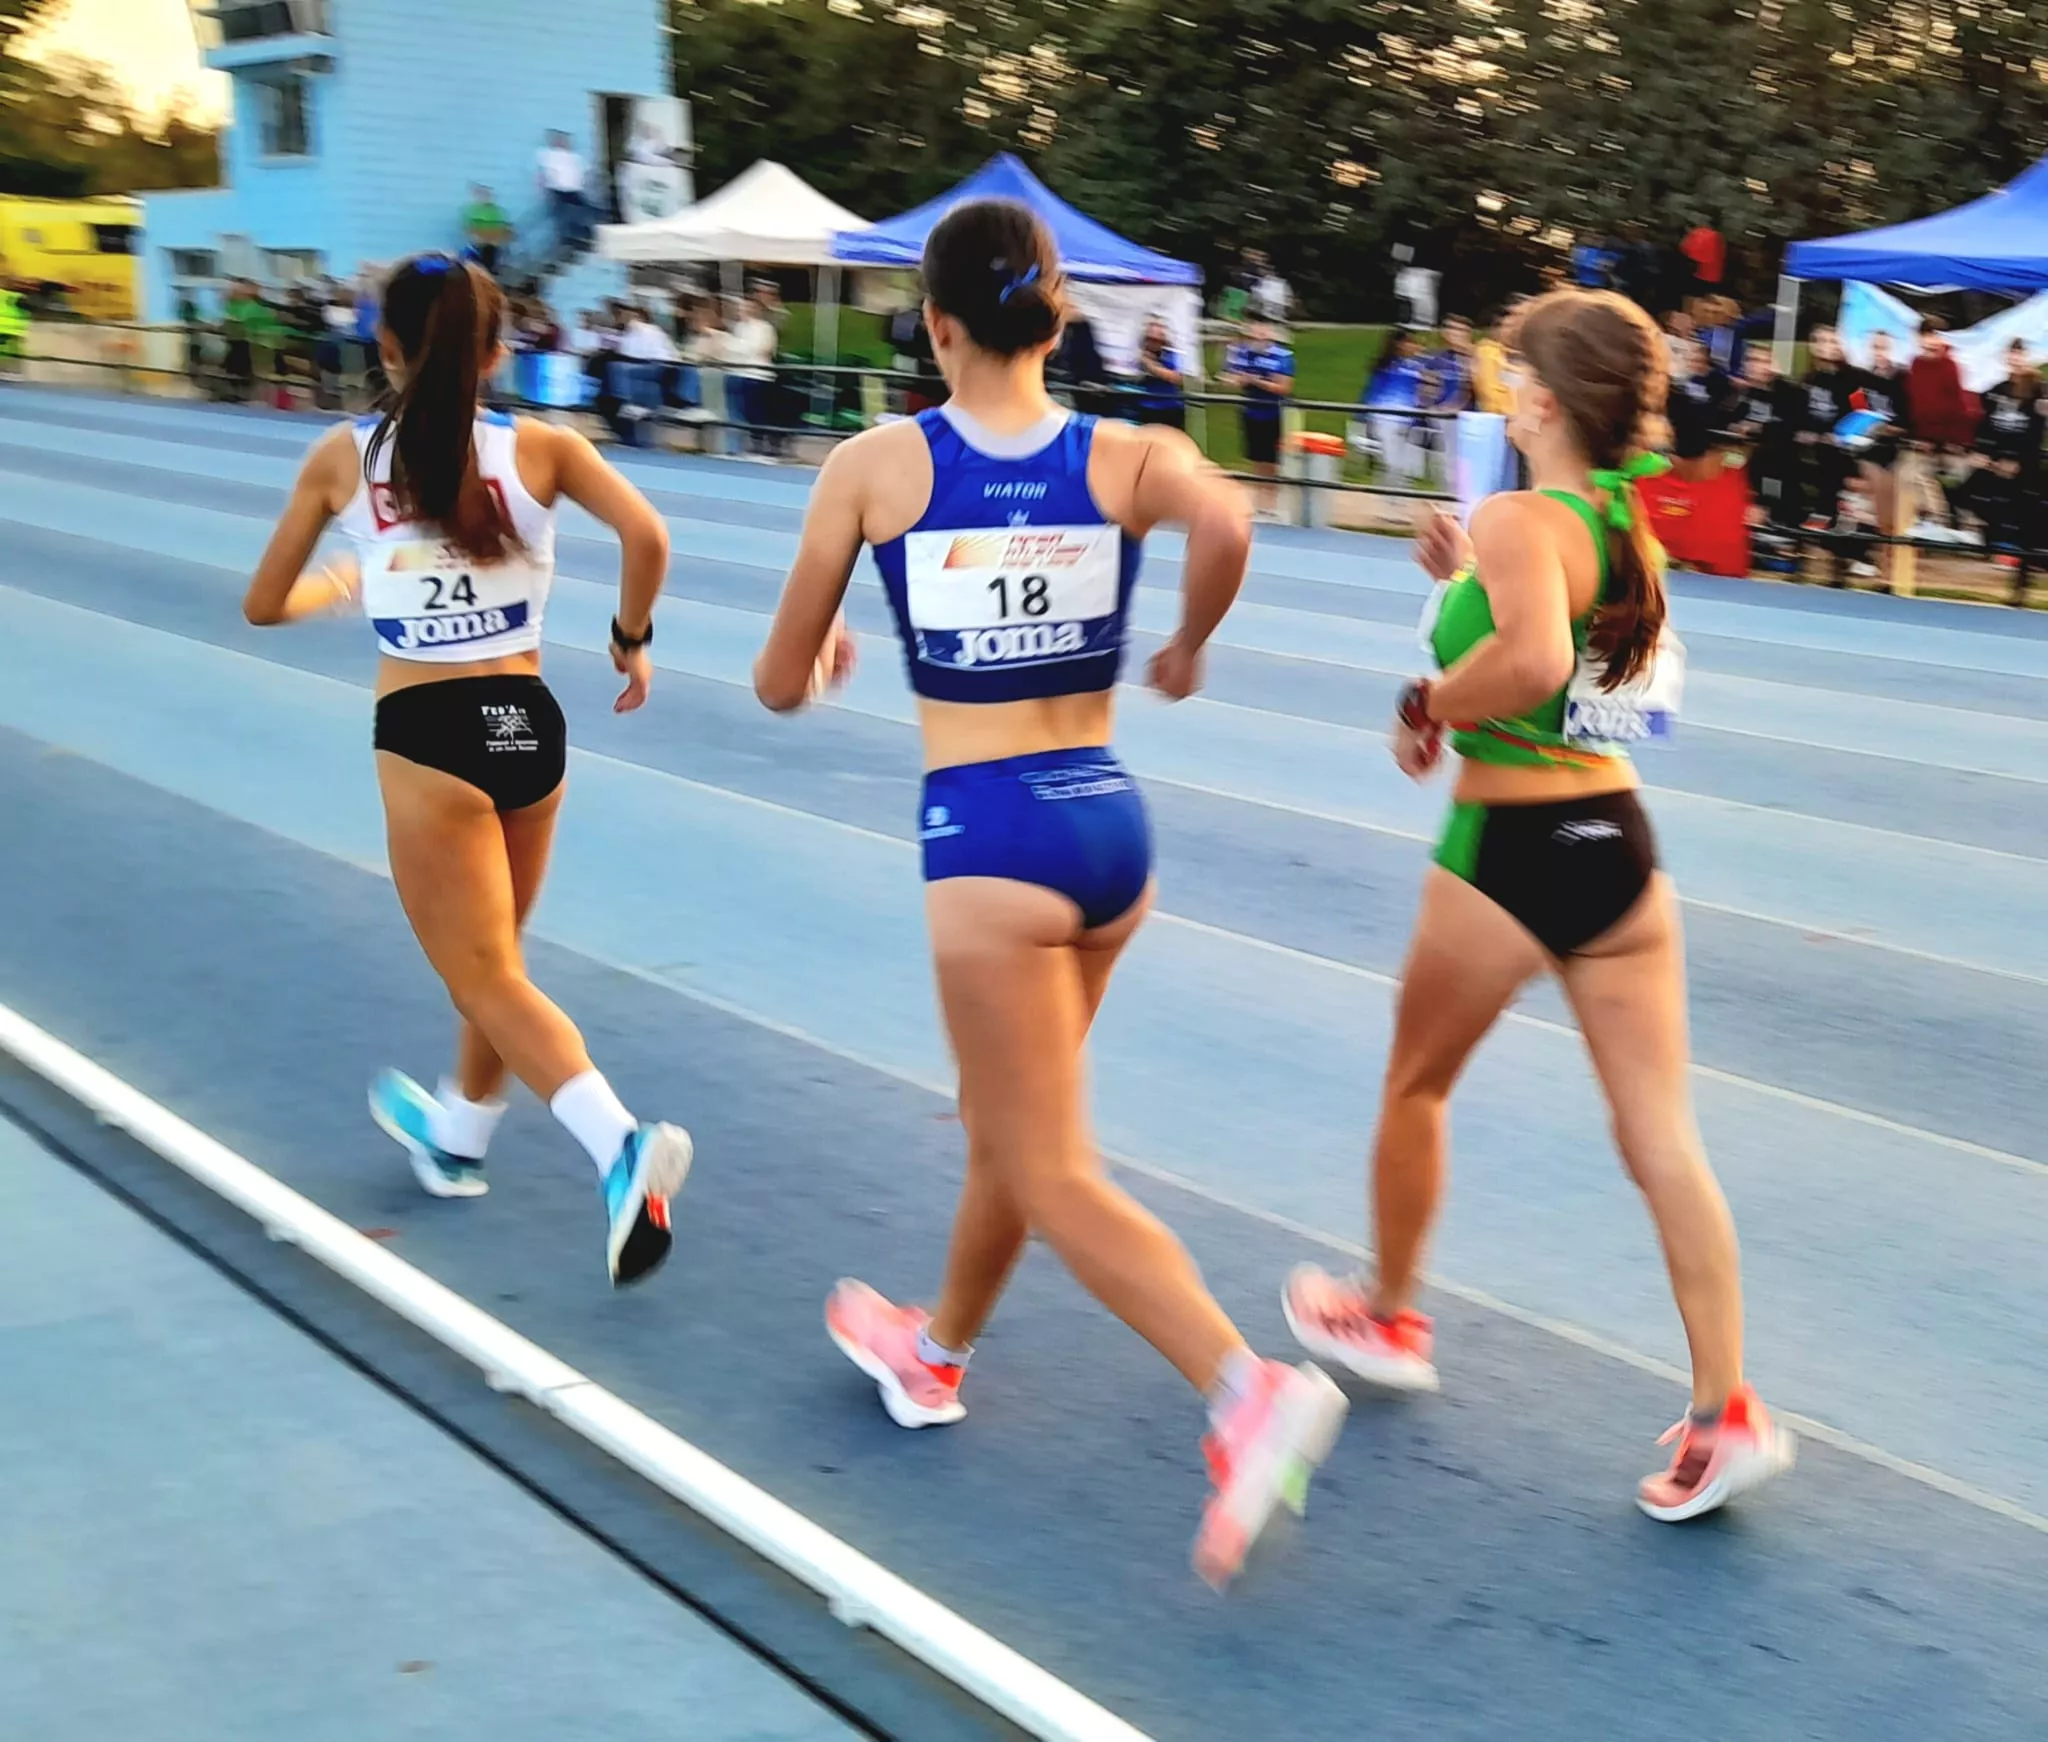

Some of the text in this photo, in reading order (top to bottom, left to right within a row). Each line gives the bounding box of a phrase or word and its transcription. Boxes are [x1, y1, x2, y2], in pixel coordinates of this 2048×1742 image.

[982, 481, 1049, 501] VIATOR
[420, 573, 479, 611] 24
[986, 574, 1052, 621] 18
